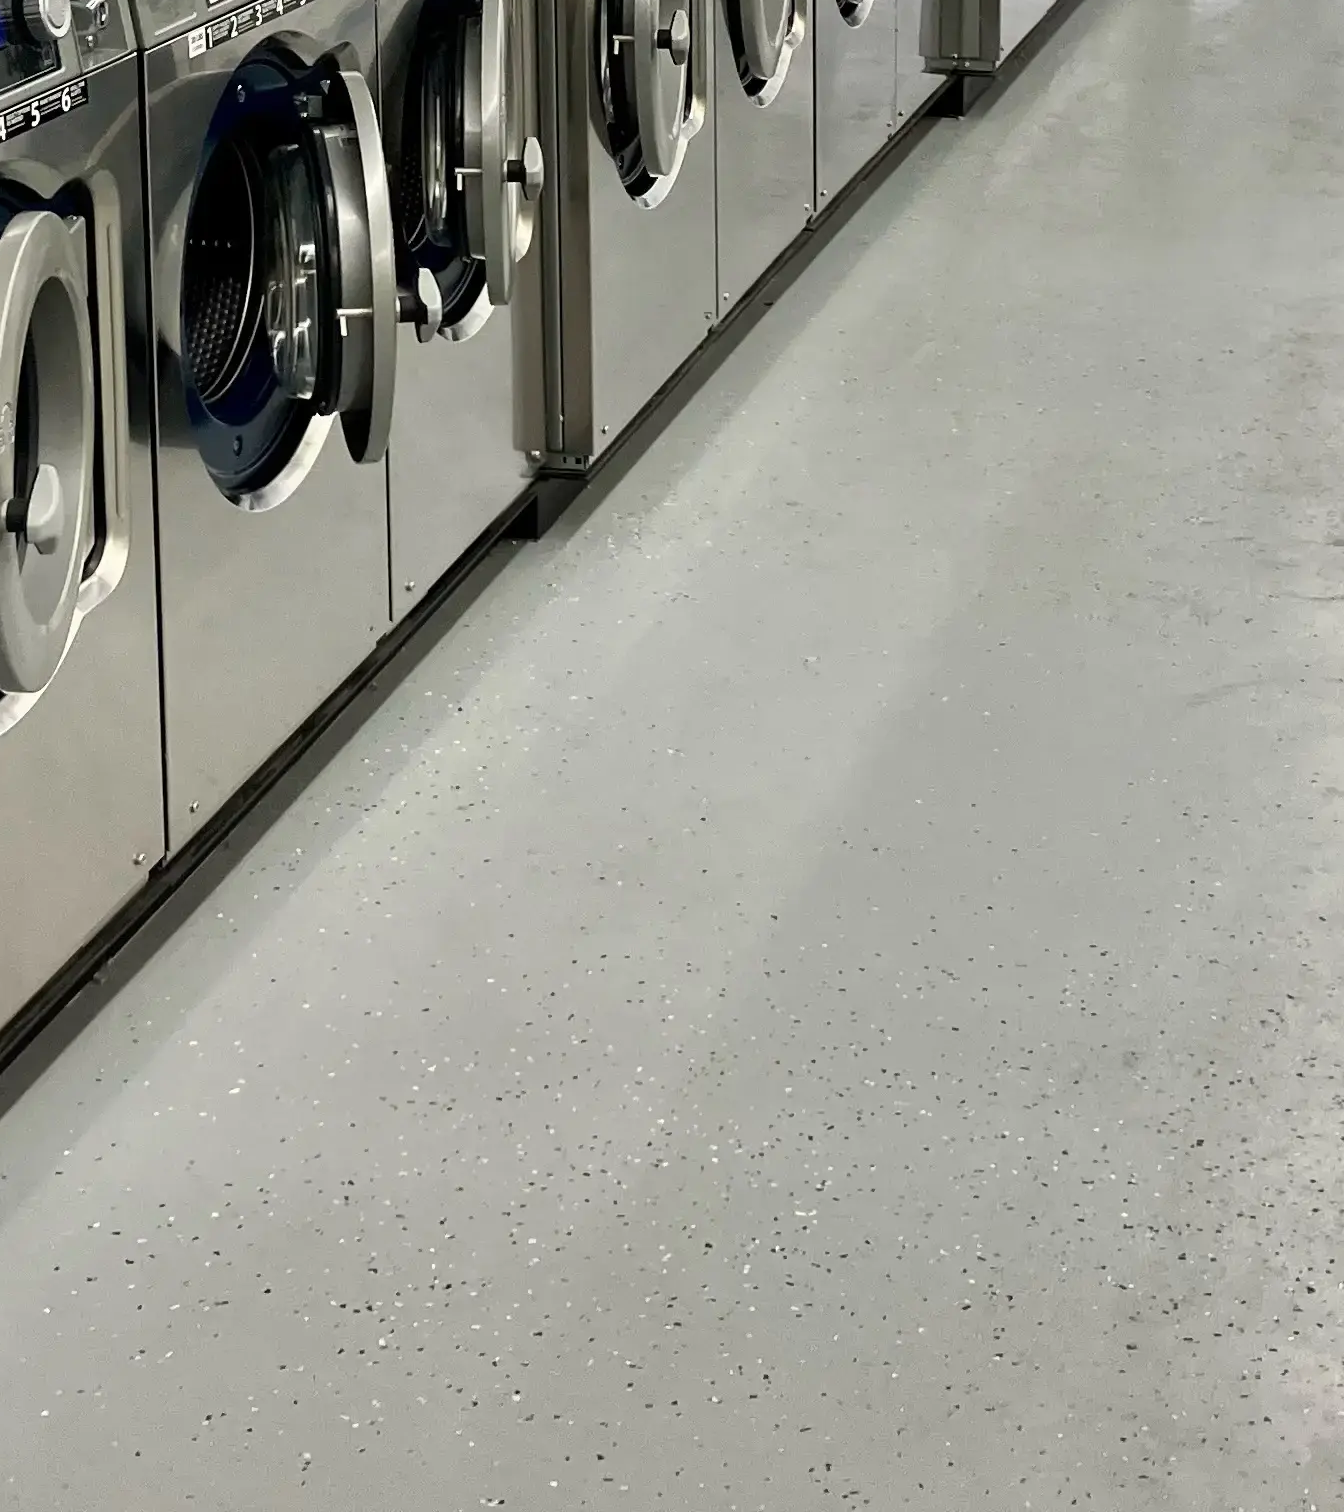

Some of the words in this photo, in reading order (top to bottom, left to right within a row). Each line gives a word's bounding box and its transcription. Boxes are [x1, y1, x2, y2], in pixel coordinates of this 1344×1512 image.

[206, 26, 213, 49] 1
[230, 16, 238, 37] 2
[255, 4, 263, 26] 3
[30, 100, 41, 127] 5
[61, 87, 72, 112] 6
